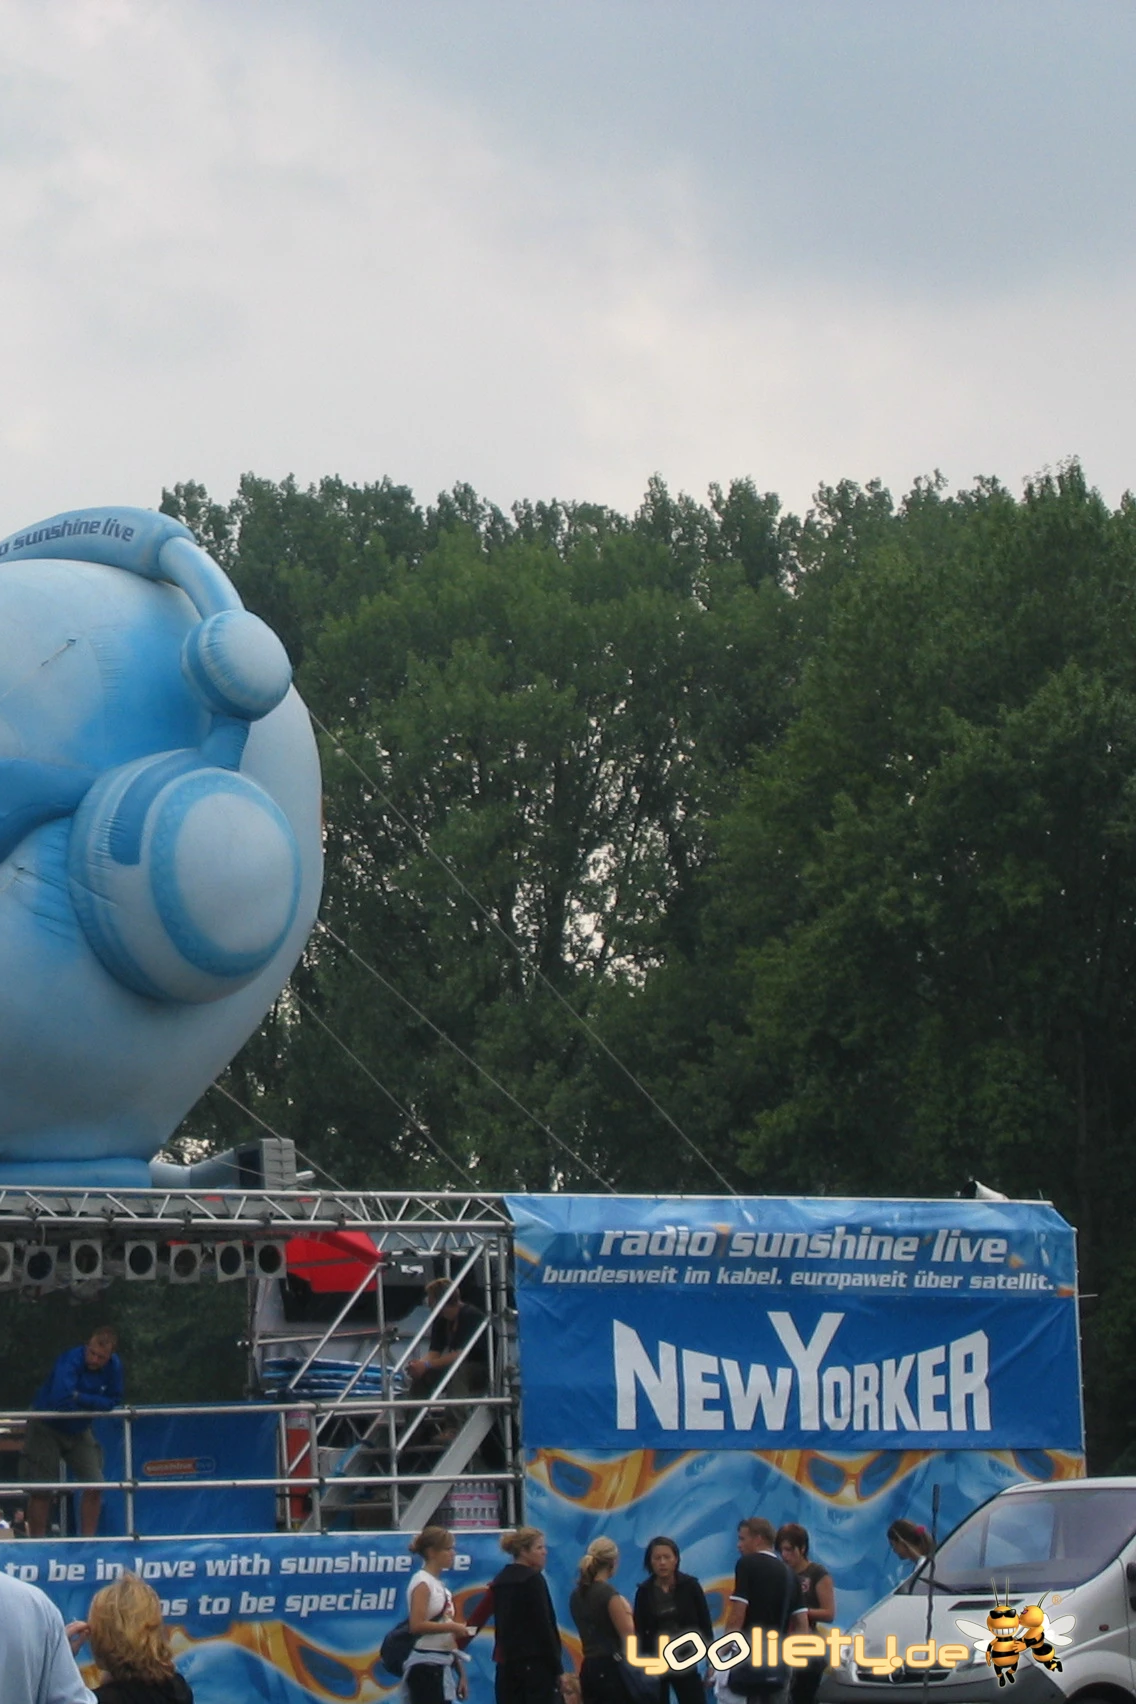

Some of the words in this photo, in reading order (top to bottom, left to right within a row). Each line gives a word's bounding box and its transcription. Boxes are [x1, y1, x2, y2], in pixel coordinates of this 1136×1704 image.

[12, 519, 101, 551] sunshine
[101, 518, 135, 542] live
[599, 1225, 717, 1258] radio
[728, 1226, 919, 1262] sunshine
[931, 1229, 1008, 1263] live
[542, 1265, 677, 1285] bundesweit
[683, 1266, 711, 1284] im
[716, 1266, 783, 1286] kabel.
[790, 1271, 908, 1291] europaweit
[914, 1271, 963, 1289] über
[969, 1272, 1055, 1291] satellit.
[4, 1562, 39, 1582] to
[48, 1559, 85, 1581] be
[96, 1559, 123, 1580] in
[134, 1557, 196, 1579] love
[205, 1553, 270, 1577] with
[279, 1551, 412, 1574] sunshine
[198, 1594, 230, 1615] to
[239, 1591, 275, 1614] be
[284, 1587, 397, 1618] special!
